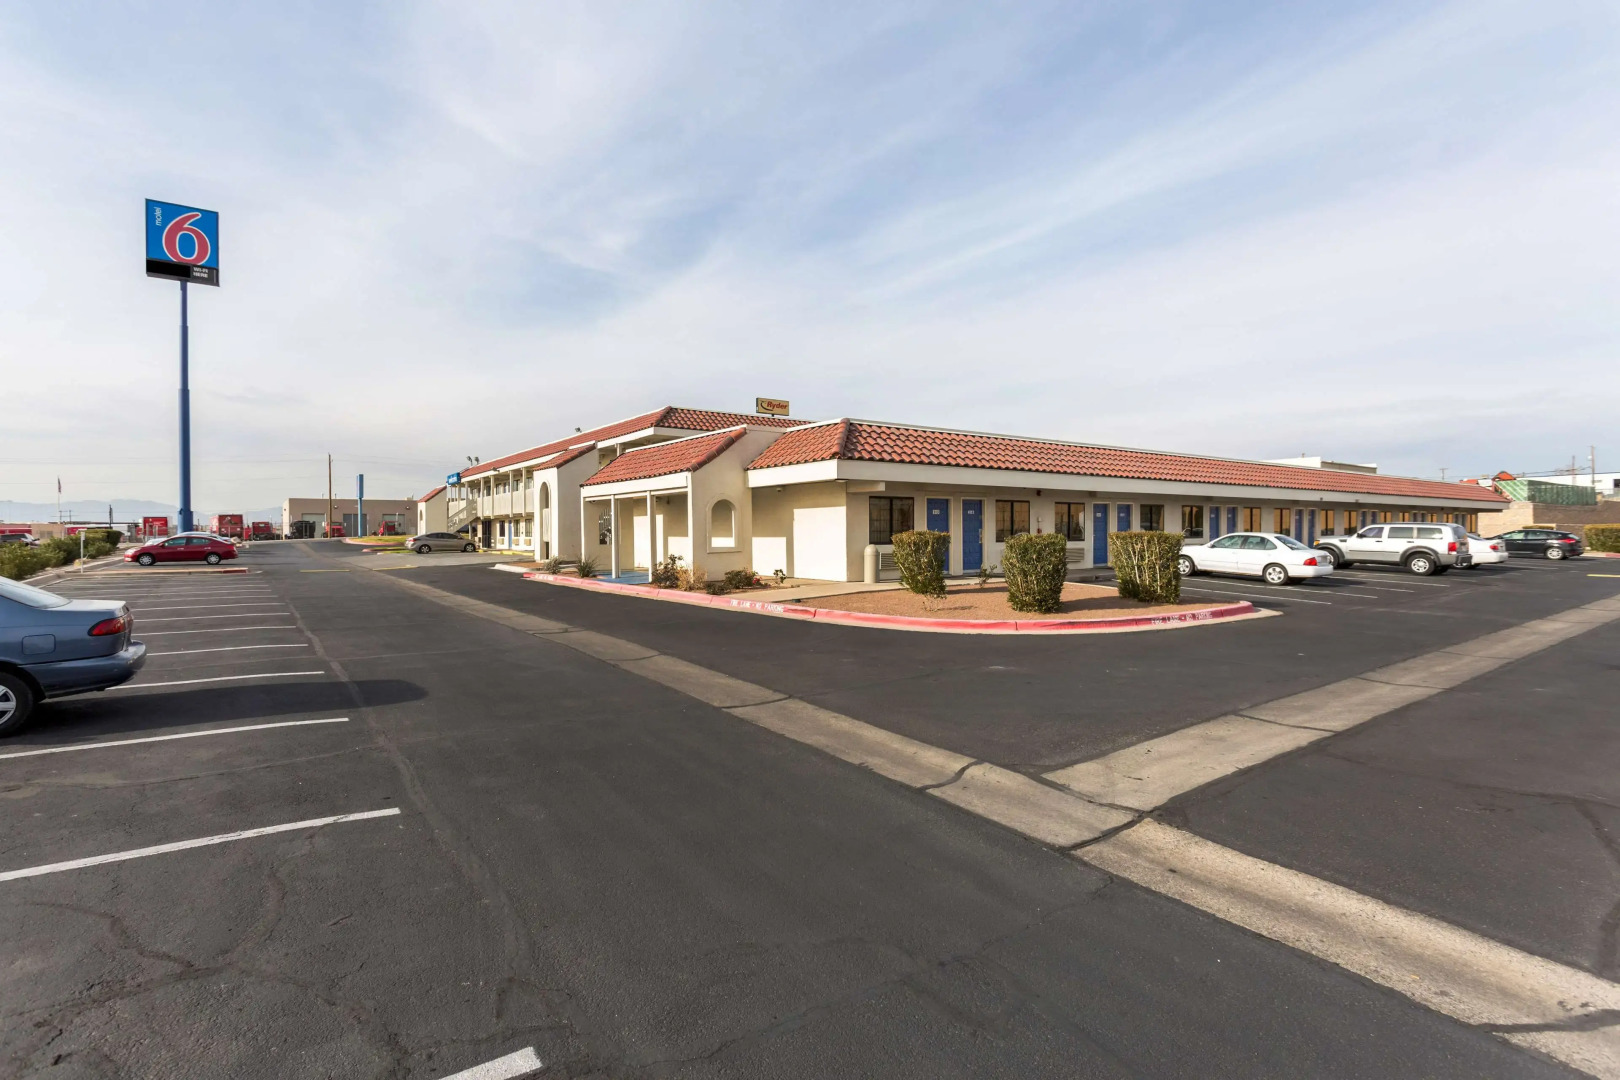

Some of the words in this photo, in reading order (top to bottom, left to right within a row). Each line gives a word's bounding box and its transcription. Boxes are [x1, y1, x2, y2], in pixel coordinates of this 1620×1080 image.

[154, 207, 162, 227] motel
[162, 212, 211, 265] 6
[767, 401, 787, 409] Ryder
